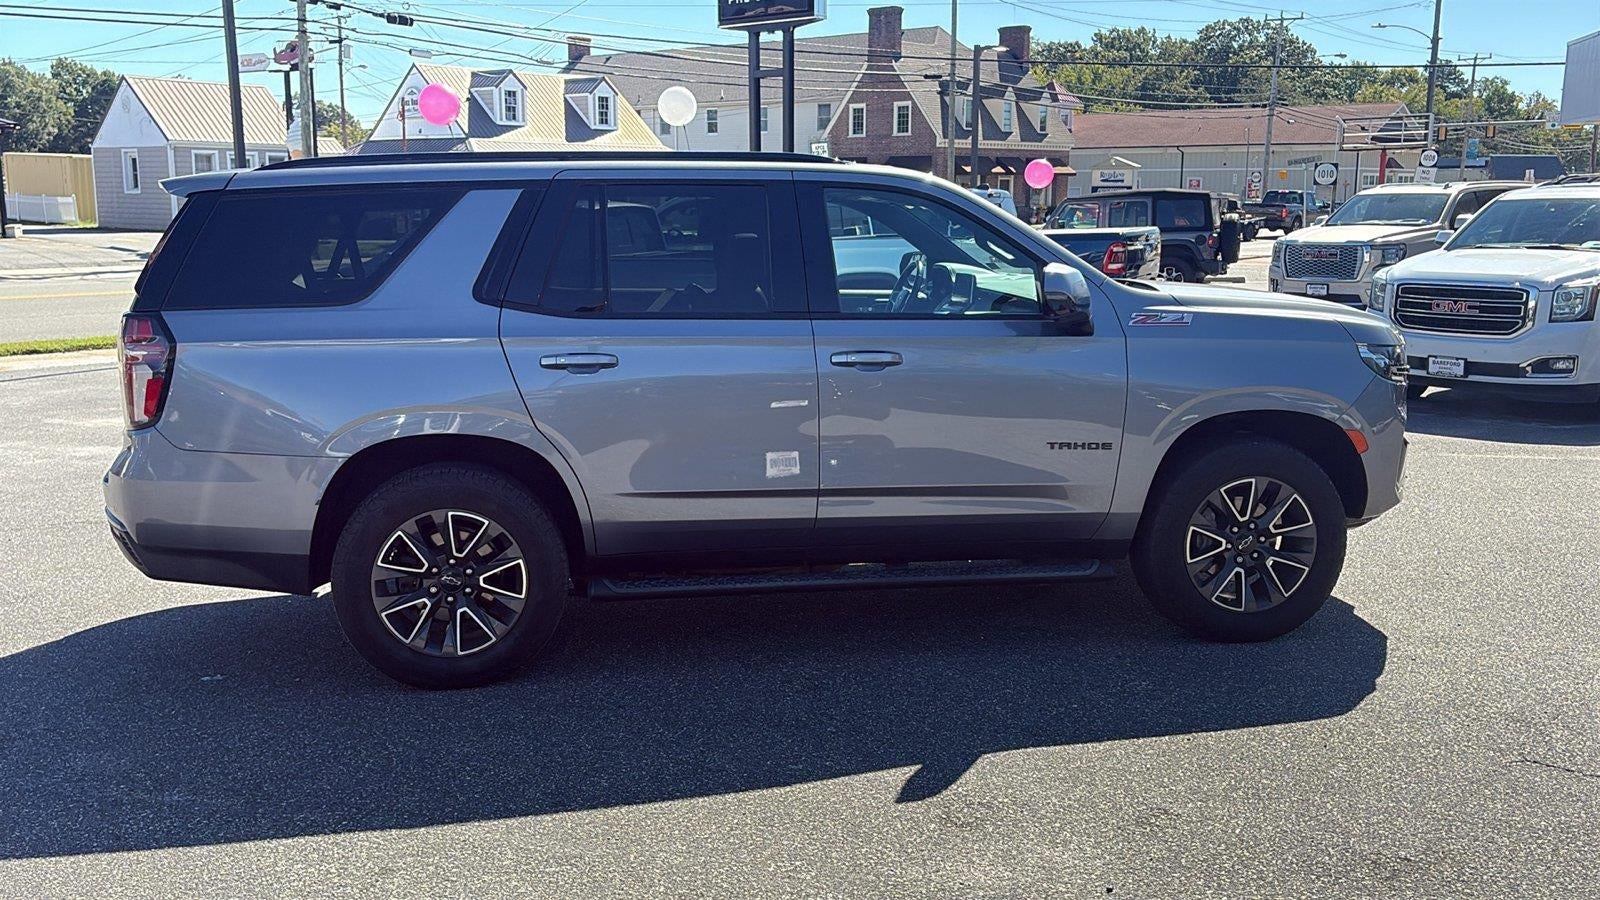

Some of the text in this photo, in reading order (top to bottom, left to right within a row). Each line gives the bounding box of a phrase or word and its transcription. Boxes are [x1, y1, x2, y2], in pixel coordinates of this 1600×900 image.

[1317, 169, 1335, 179] 1010
[1432, 300, 1480, 314] GMC
[1128, 312, 1194, 326] Z71
[1432, 359, 1462, 368] BAREFORD
[1046, 441, 1113, 450] TAHOE
